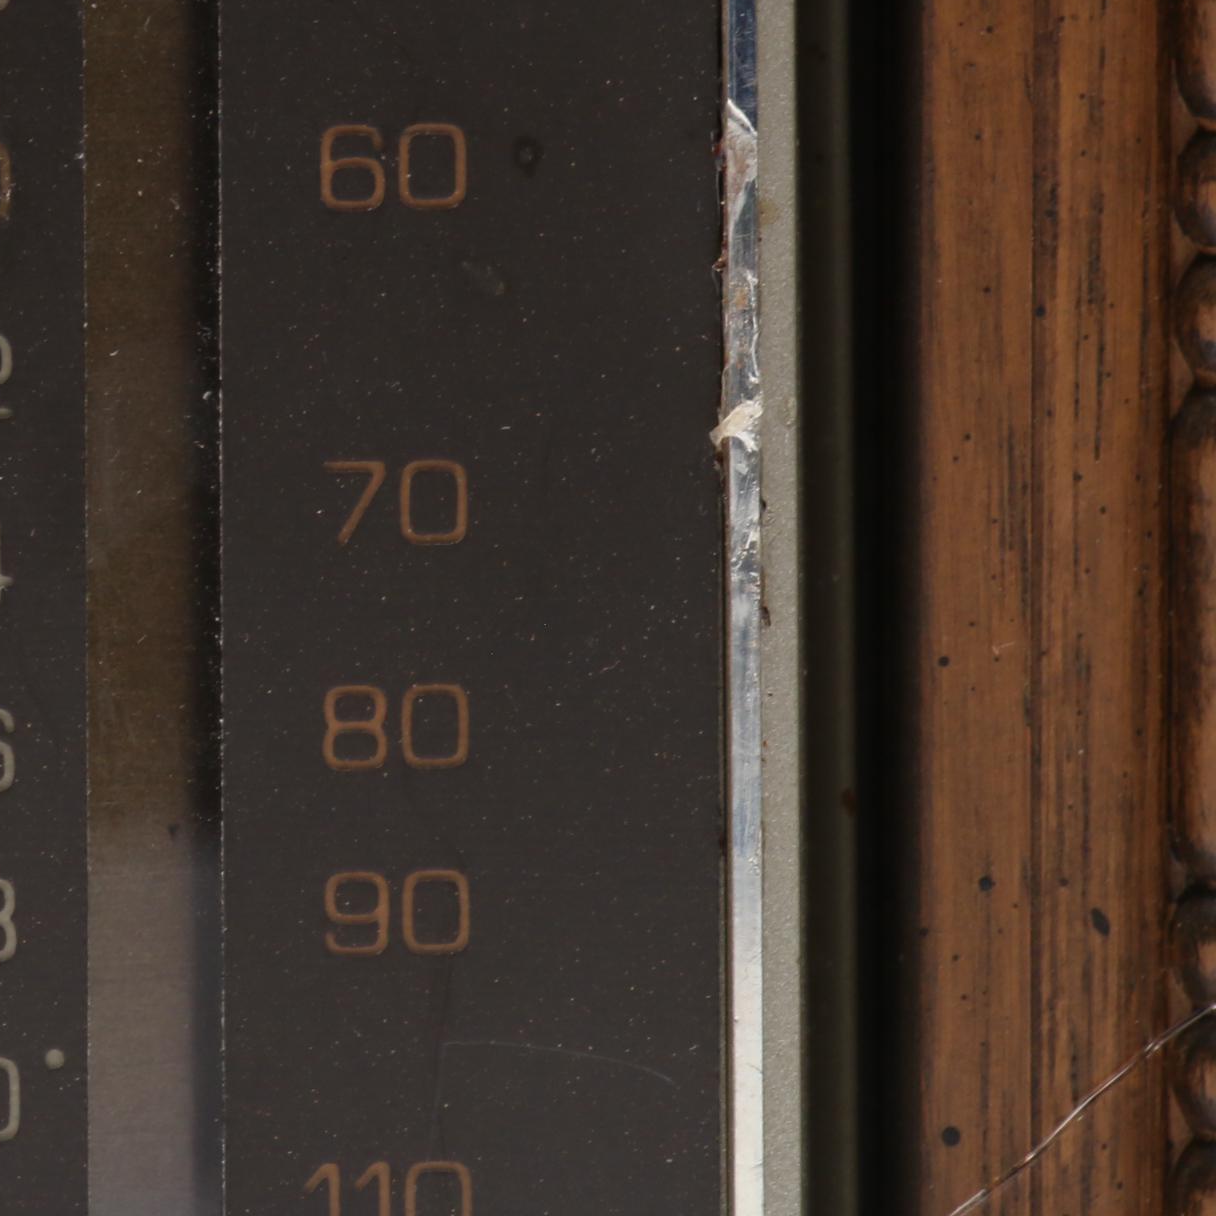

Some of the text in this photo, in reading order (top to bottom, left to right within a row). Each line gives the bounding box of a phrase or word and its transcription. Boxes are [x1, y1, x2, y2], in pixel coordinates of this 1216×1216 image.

[320, 123, 467, 212] 60
[323, 458, 469, 547] 70
[323, 684, 470, 771] 80
[324, 869, 470, 956] 90
